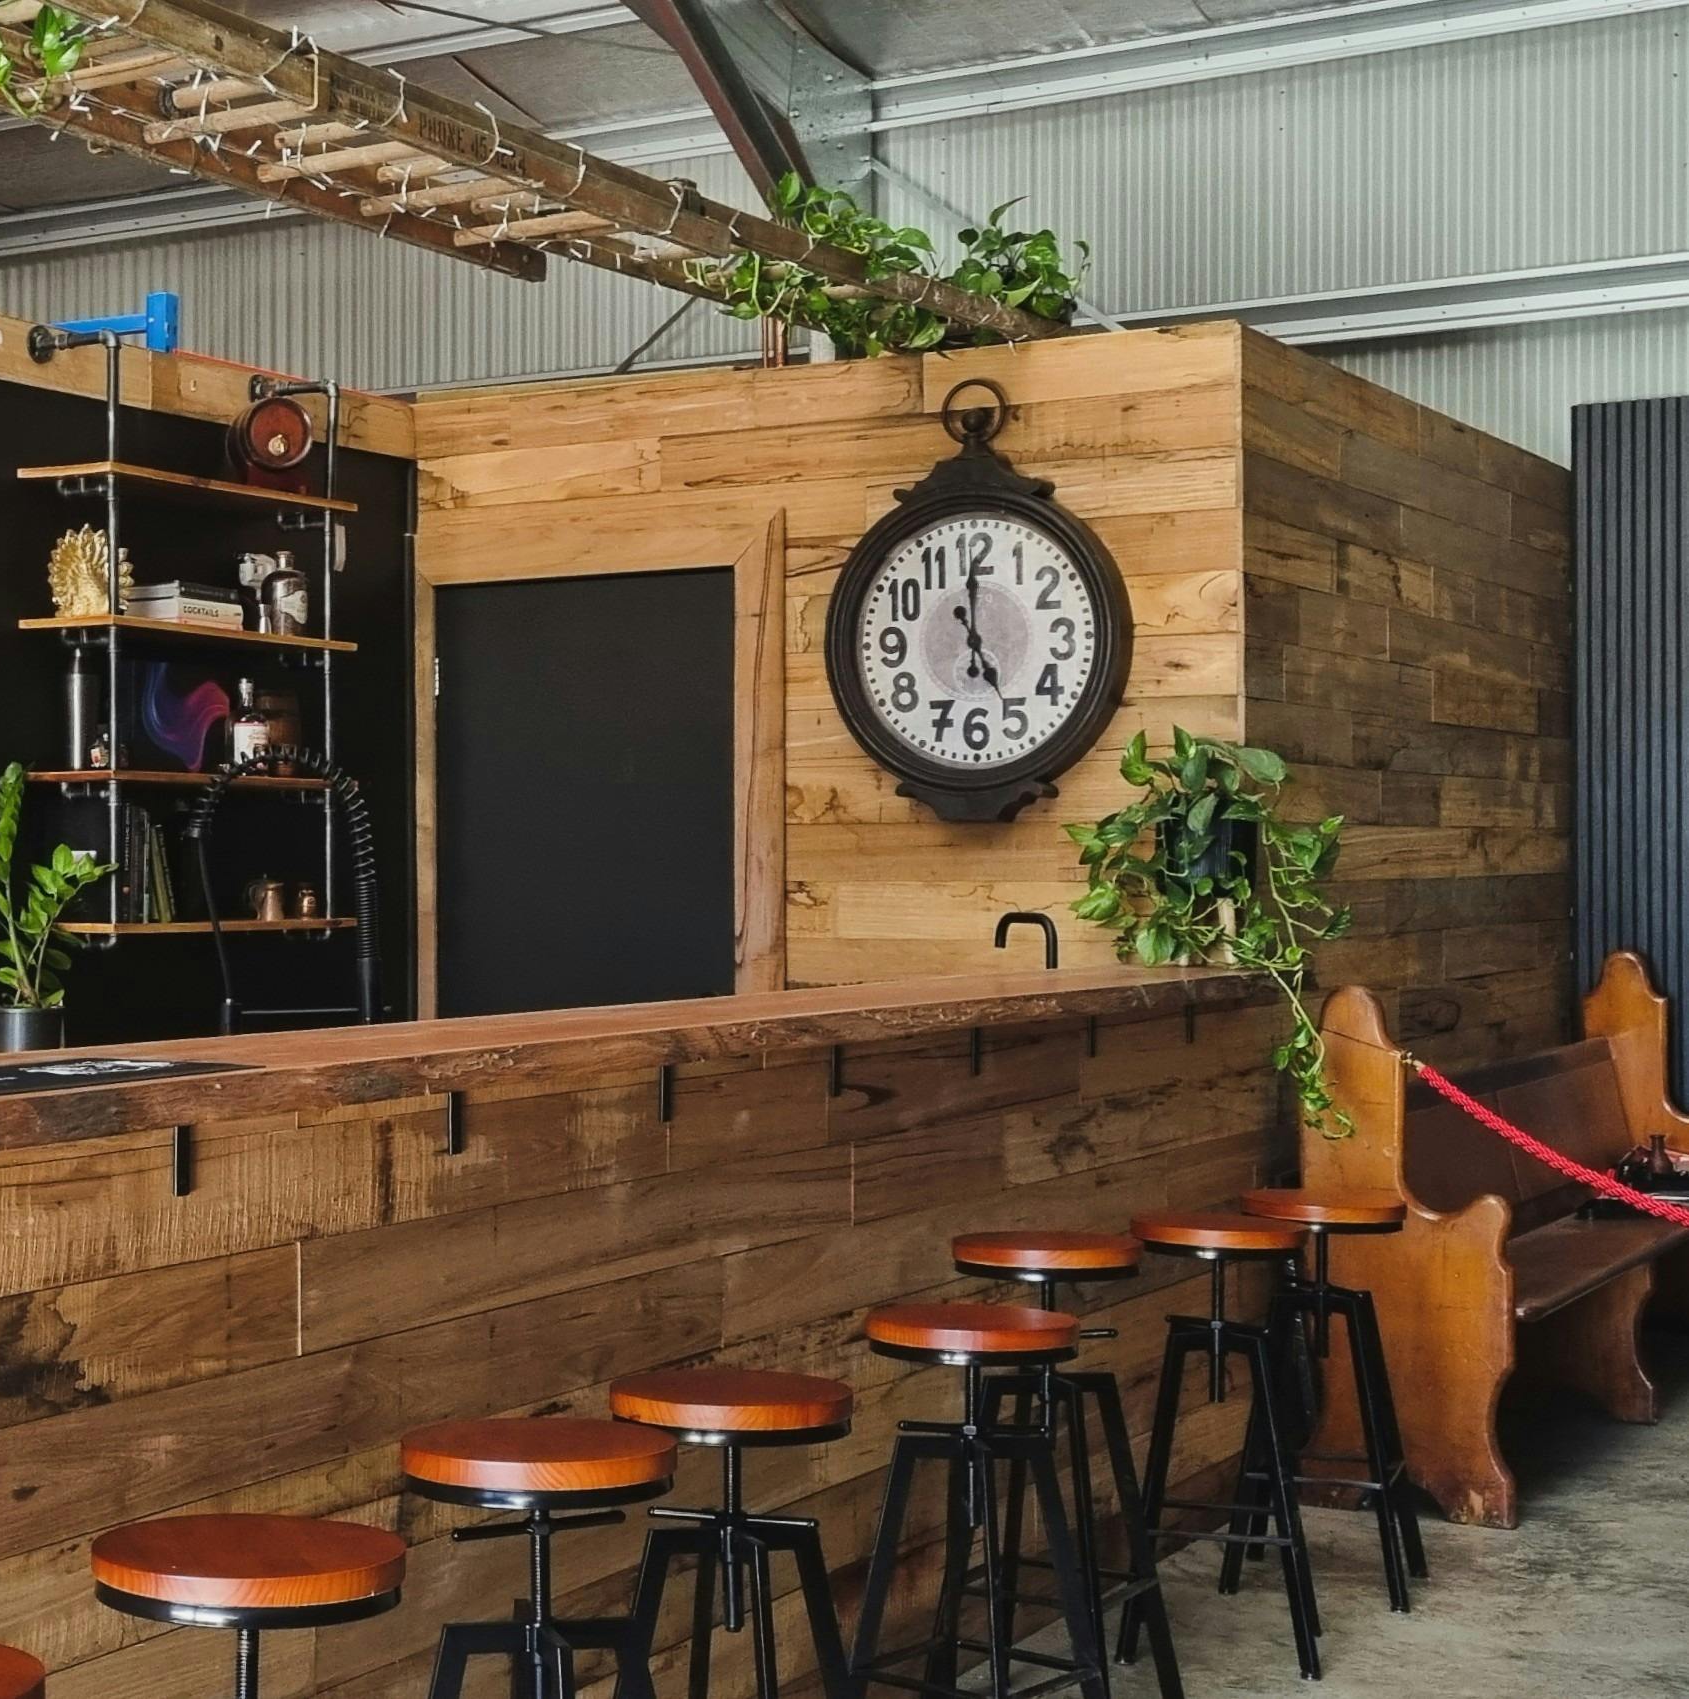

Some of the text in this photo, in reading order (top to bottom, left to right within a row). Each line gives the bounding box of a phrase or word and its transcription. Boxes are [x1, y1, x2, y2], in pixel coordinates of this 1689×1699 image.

[419, 111, 466, 154] PHONE
[921, 546, 946, 590] 11
[955, 532, 995, 576] 12
[1012, 541, 1024, 585] 1
[888, 578, 921, 622] 10
[1035, 565, 1062, 610] 2
[183, 604, 220, 618] COCKTAILS
[879, 626, 908, 668] 9
[1049, 617, 1077, 661] 3
[891, 671, 919, 713] 8
[1035, 663, 1065, 706] 4
[929, 700, 955, 742] 7
[963, 707, 990, 751] 6
[1002, 697, 1029, 740] 5
